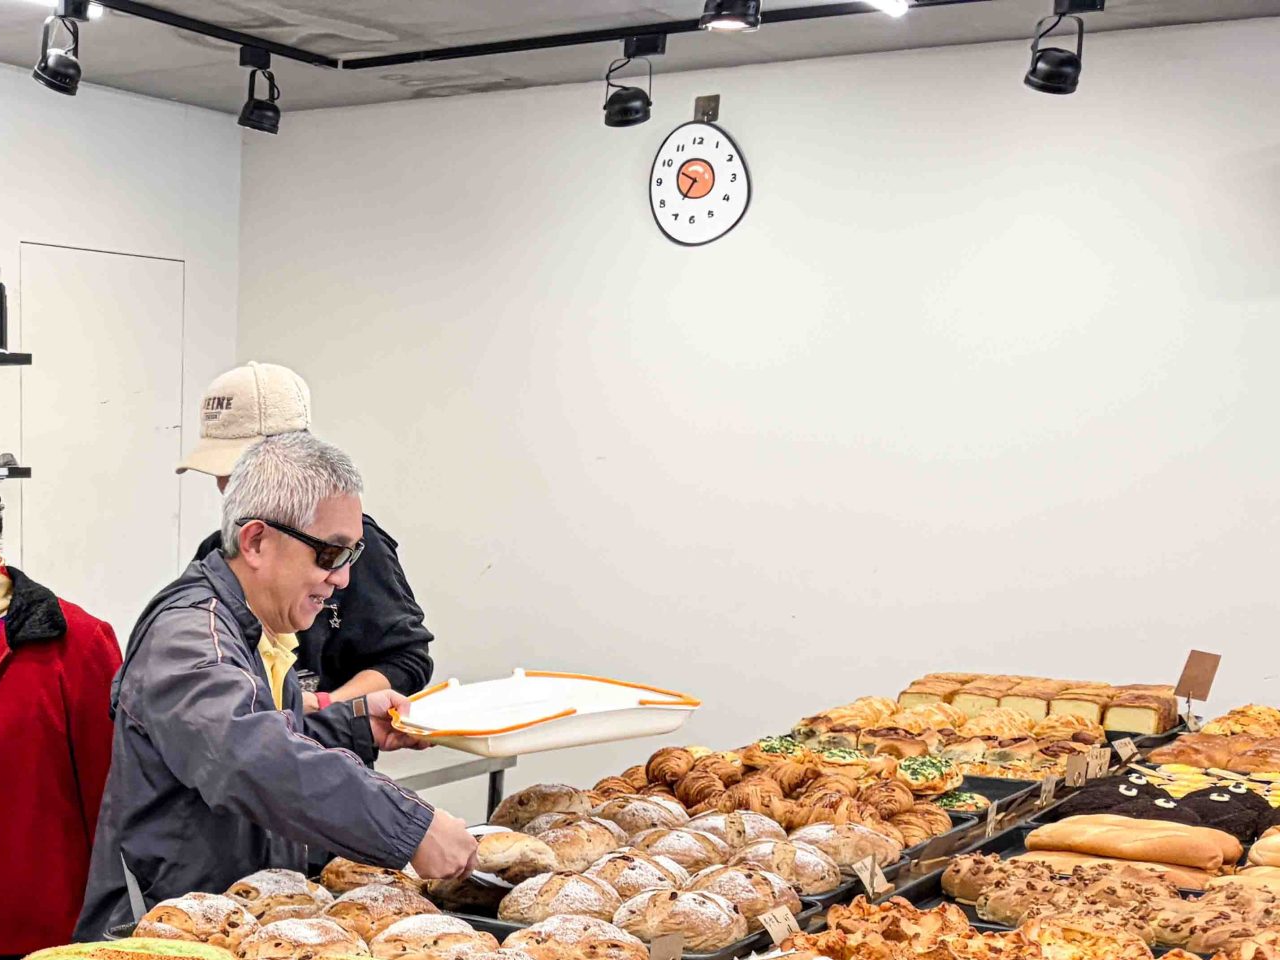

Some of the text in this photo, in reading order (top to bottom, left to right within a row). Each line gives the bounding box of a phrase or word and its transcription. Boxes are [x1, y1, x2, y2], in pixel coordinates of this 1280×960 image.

[692, 137, 704, 145] 12
[715, 141, 719, 149] 1
[676, 144, 685, 152] 11
[726, 154, 734, 162] 2
[662, 158, 673, 167] 10
[730, 173, 737, 182] 3
[656, 178, 663, 186] 9
[722, 193, 730, 202] 4
[659, 199, 666, 208] 8
[671, 213, 679, 221] 7
[707, 210, 714, 218] 5
[688, 215, 695, 224] 6
